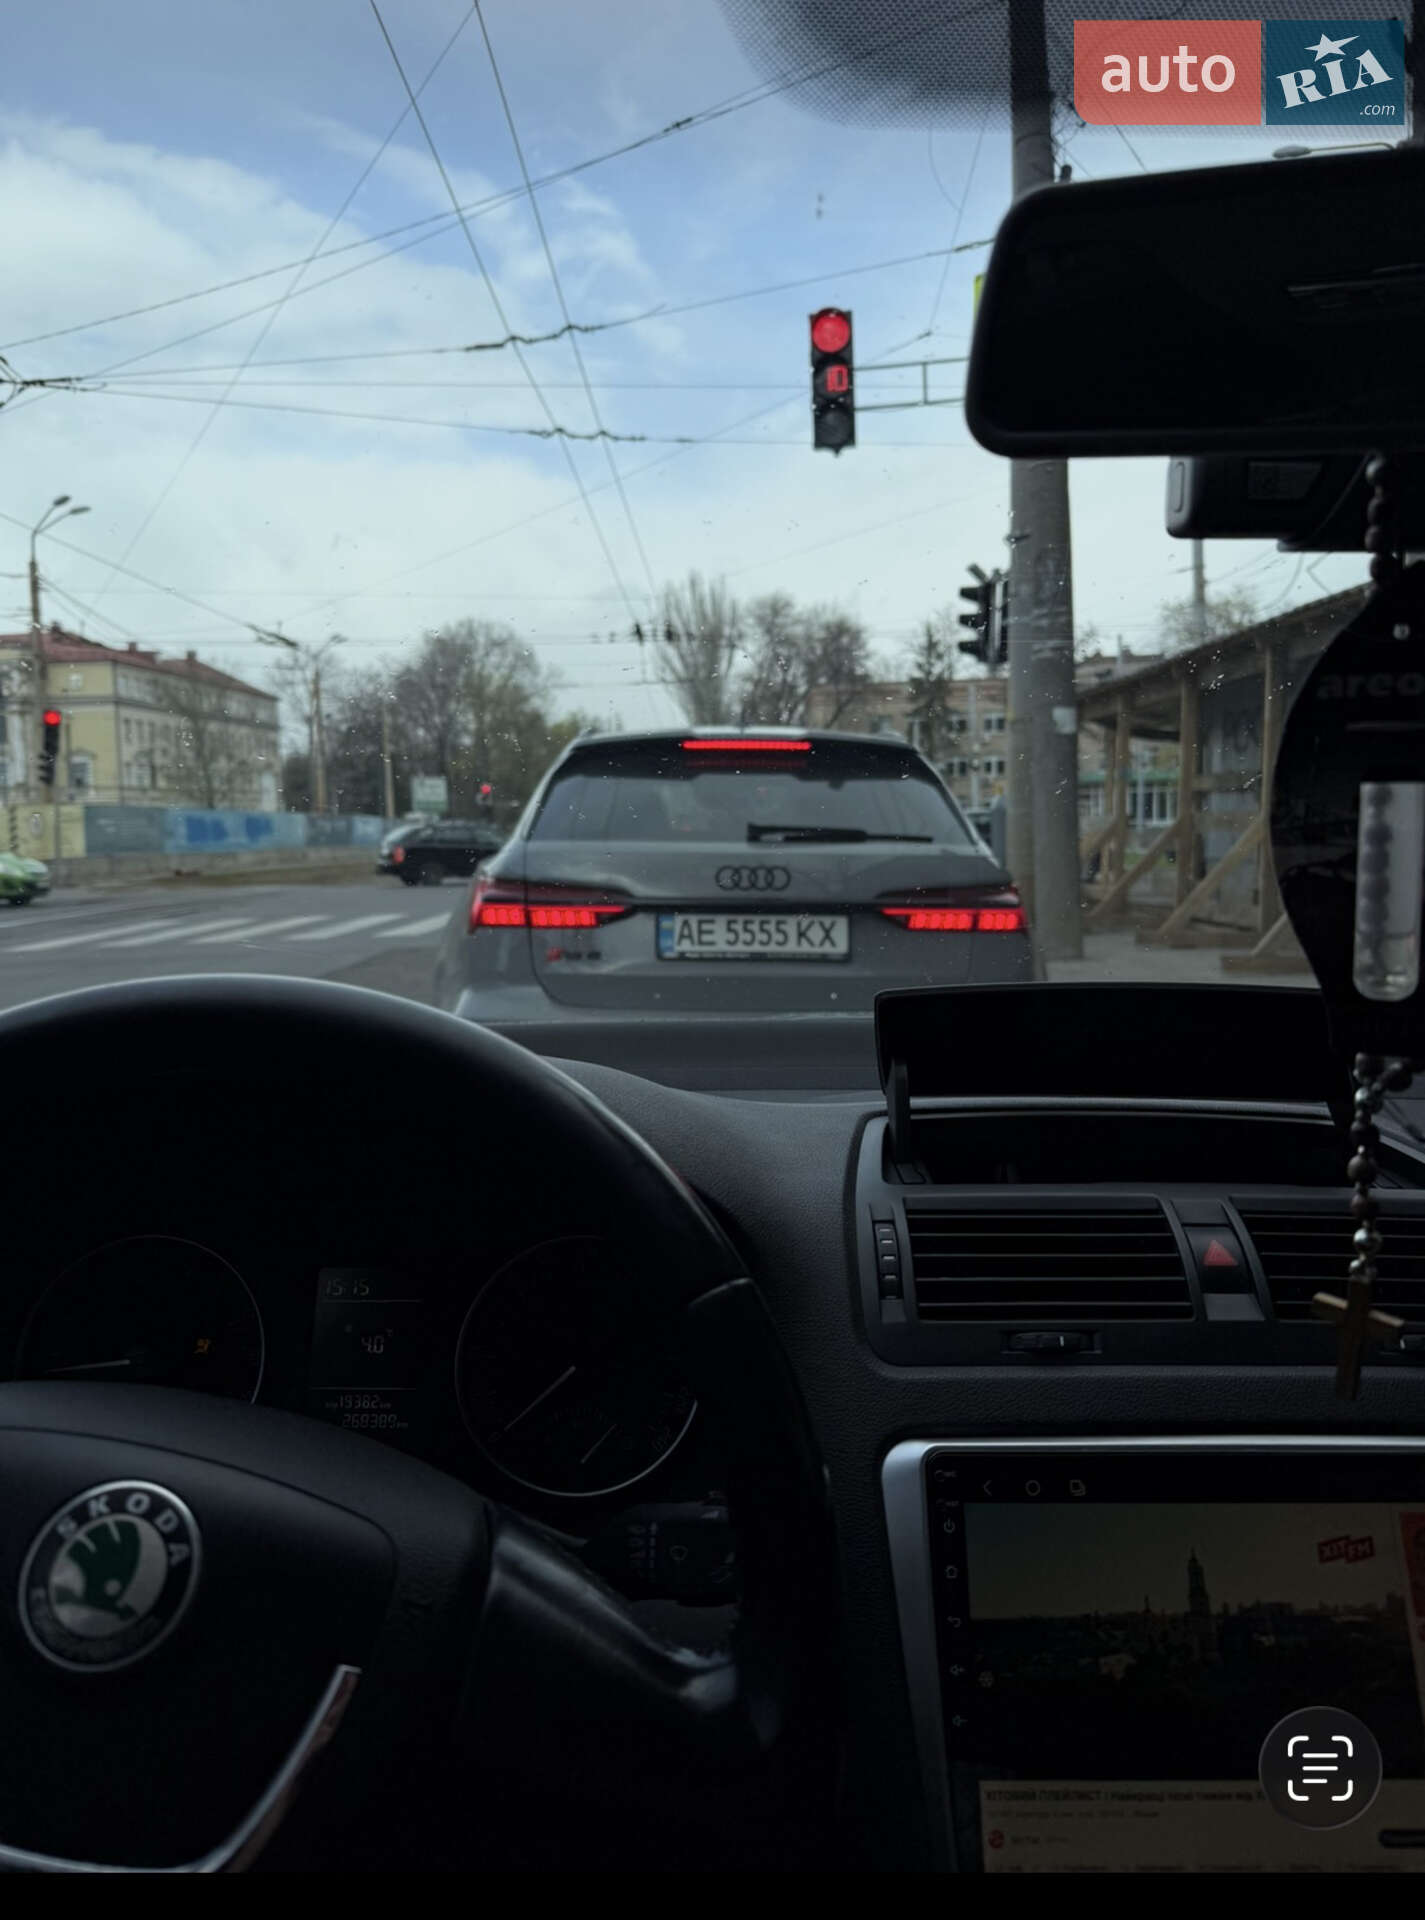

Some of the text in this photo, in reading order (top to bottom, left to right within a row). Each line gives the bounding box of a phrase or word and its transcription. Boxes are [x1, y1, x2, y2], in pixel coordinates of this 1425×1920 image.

[677, 919, 837, 948] AE 5555 KX
